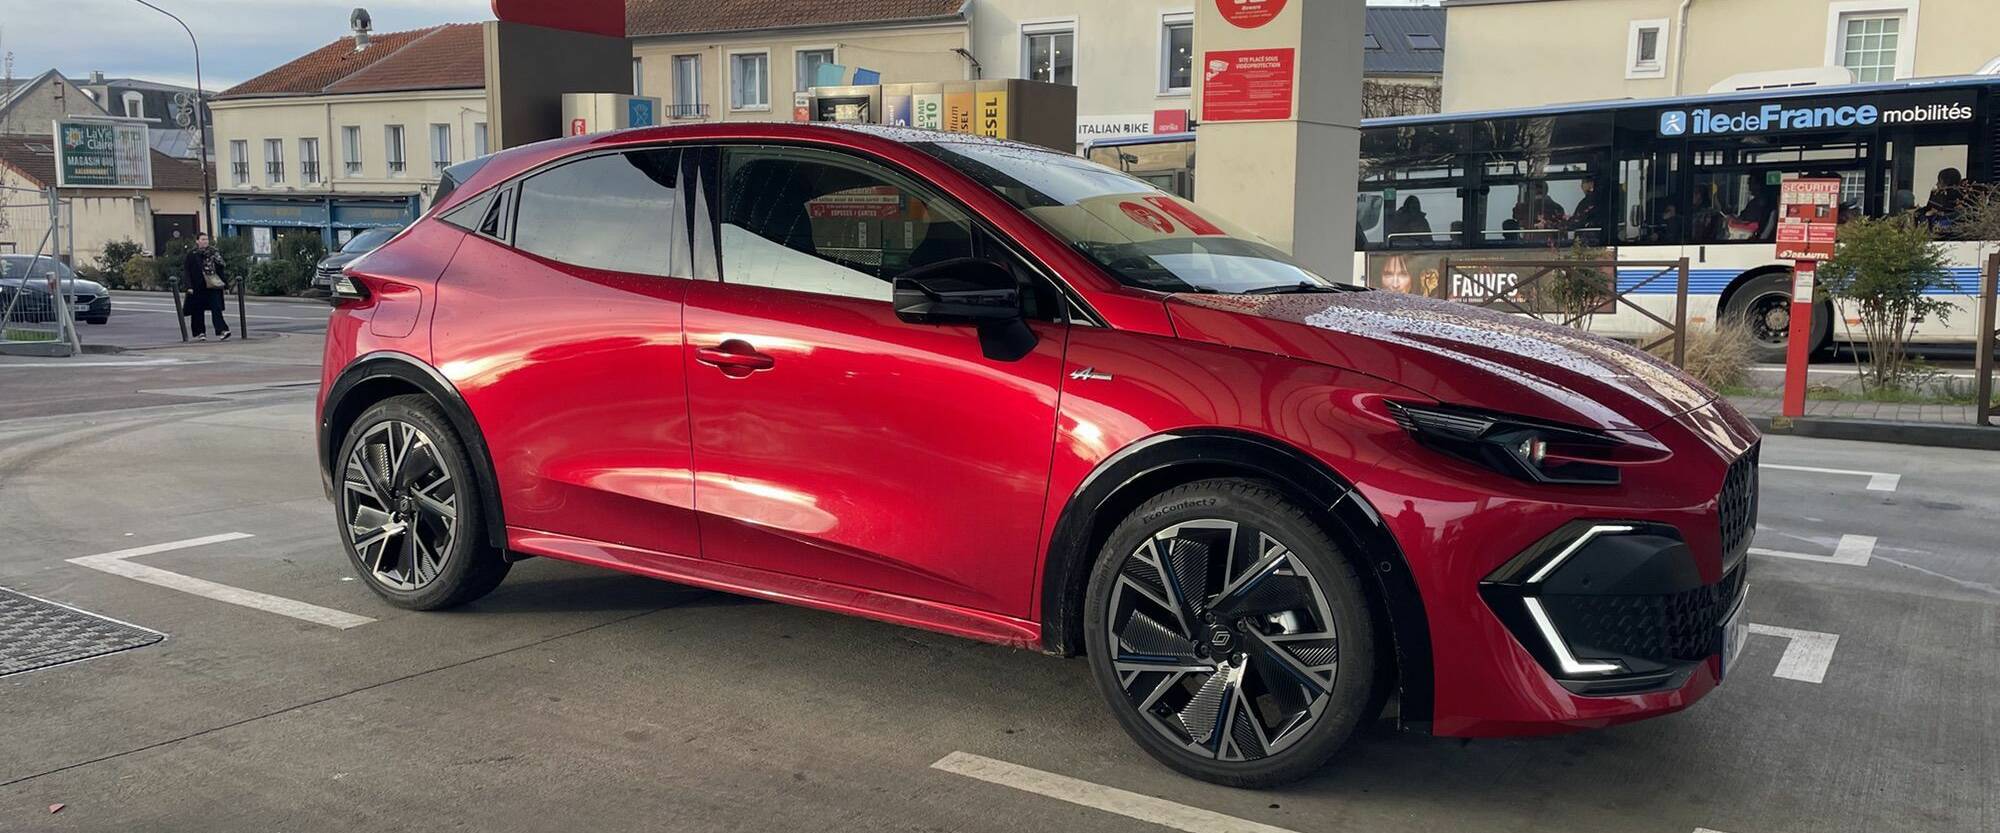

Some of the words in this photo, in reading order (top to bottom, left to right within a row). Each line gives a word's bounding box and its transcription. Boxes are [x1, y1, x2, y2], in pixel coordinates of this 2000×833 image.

[1883, 103, 1973, 123] mobilités
[1078, 124, 1121, 134] ITALIAN
[1123, 123, 1149, 133] BIKE
[1452, 272, 1519, 297] FAUVES
